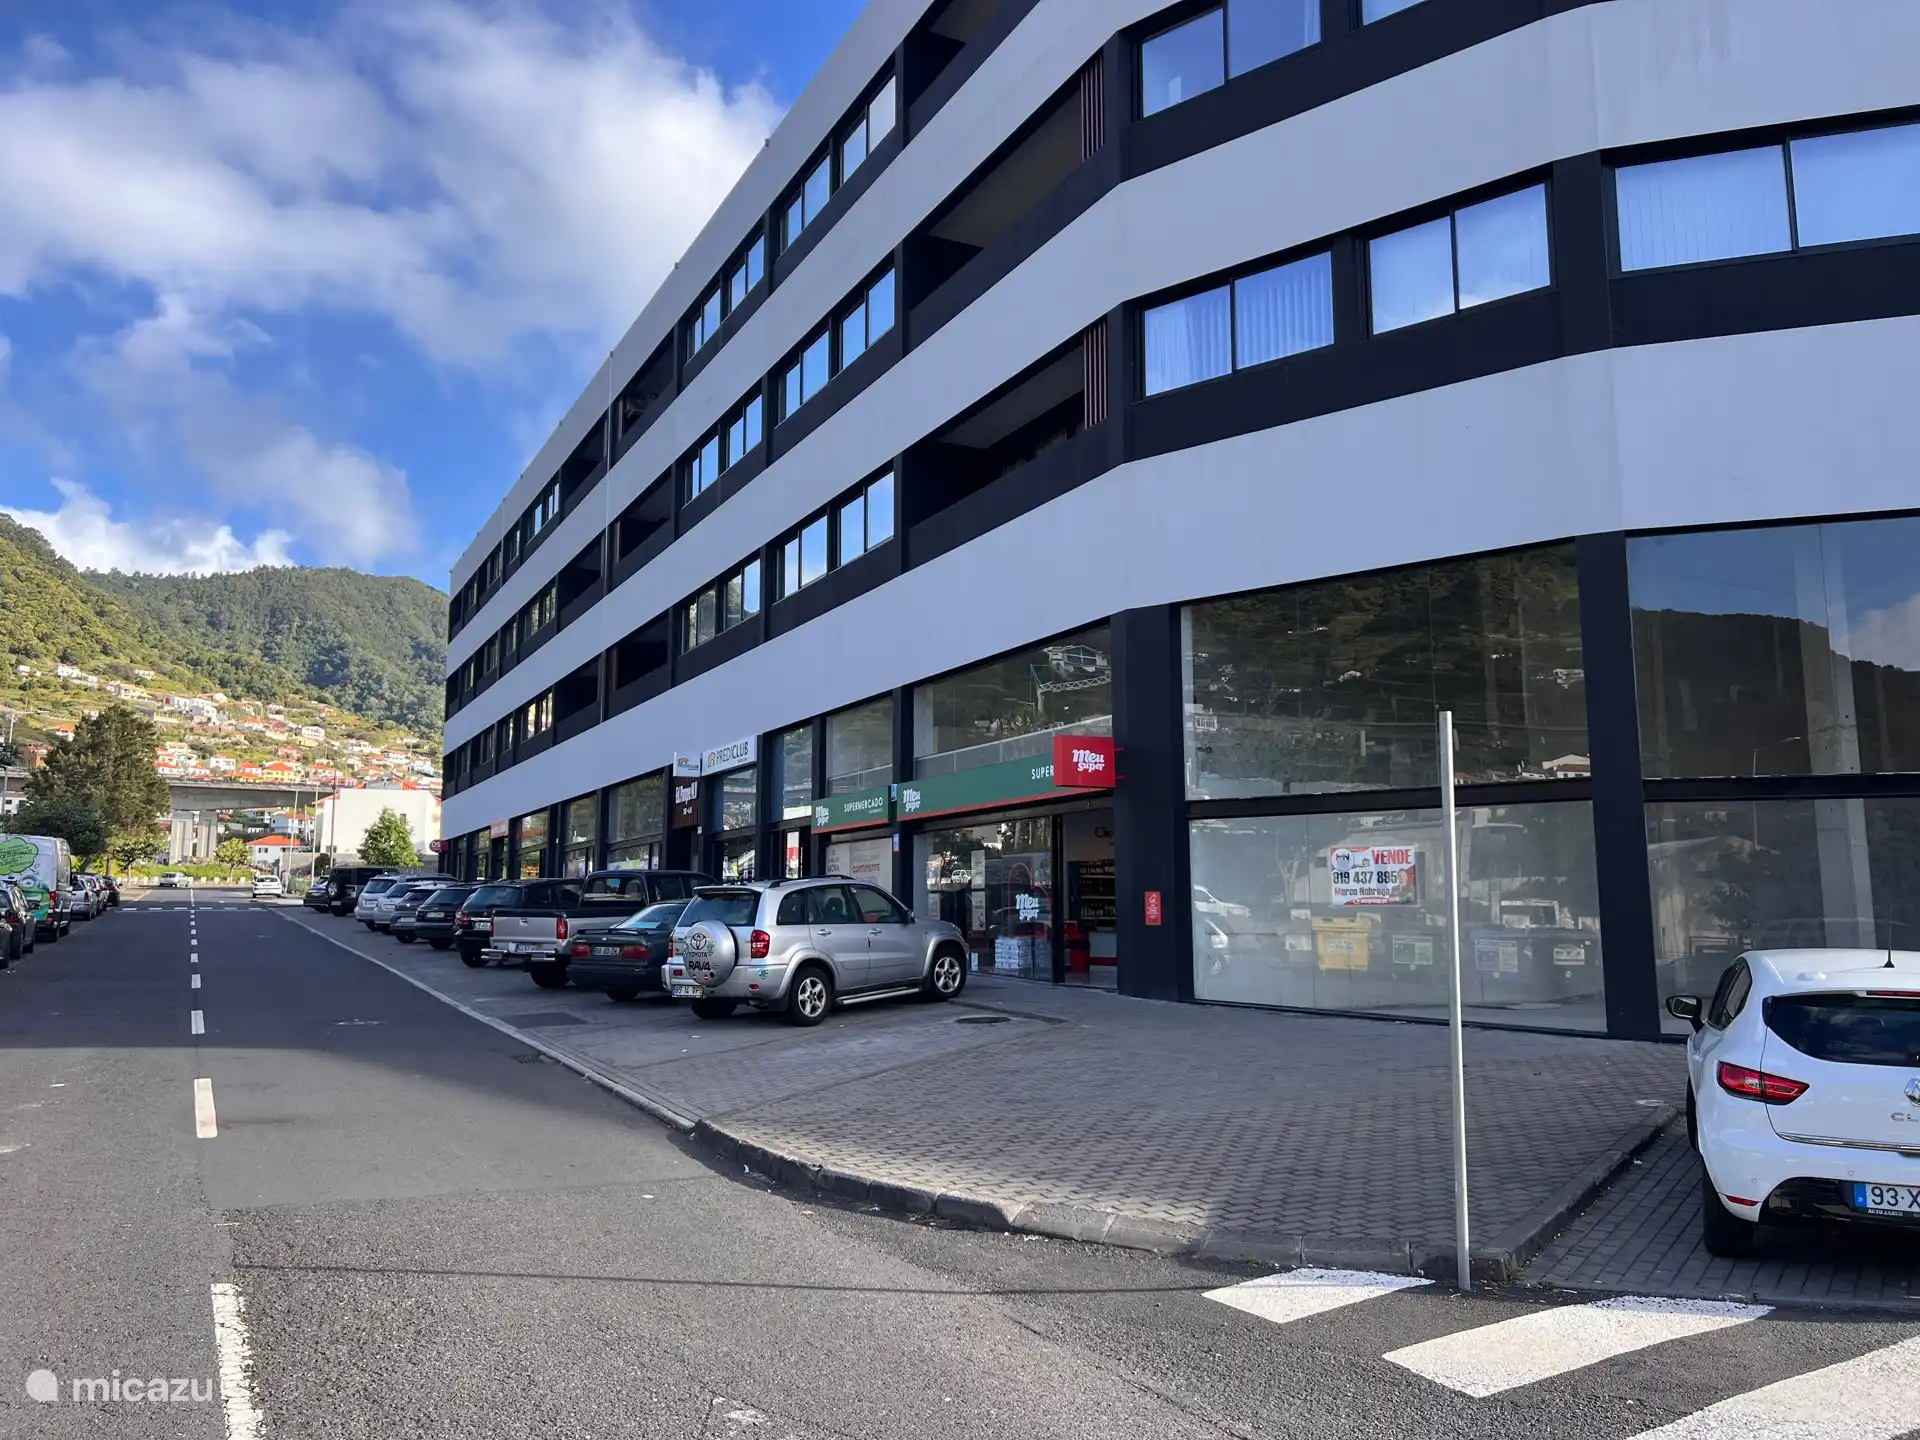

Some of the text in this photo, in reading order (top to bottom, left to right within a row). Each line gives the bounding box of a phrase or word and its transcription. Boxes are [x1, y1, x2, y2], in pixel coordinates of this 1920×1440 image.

[716, 741, 749, 762] PREDICLUB
[1072, 749, 1105, 764] Meu
[1077, 761, 1105, 772] super
[903, 788, 921, 803] Meu
[843, 796, 884, 813] SUPERMERCADO
[905, 800, 921, 812] super
[815, 805, 829, 818] Meu
[1372, 849, 1412, 864] VENDE
[1333, 872, 1350, 884] 919
[1353, 871, 1374, 884] 437
[1335, 887, 1358, 897] Marco
[1015, 893, 1039, 910] Meu
[1019, 908, 1039, 921] super
[688, 960, 711, 971] RAV4
